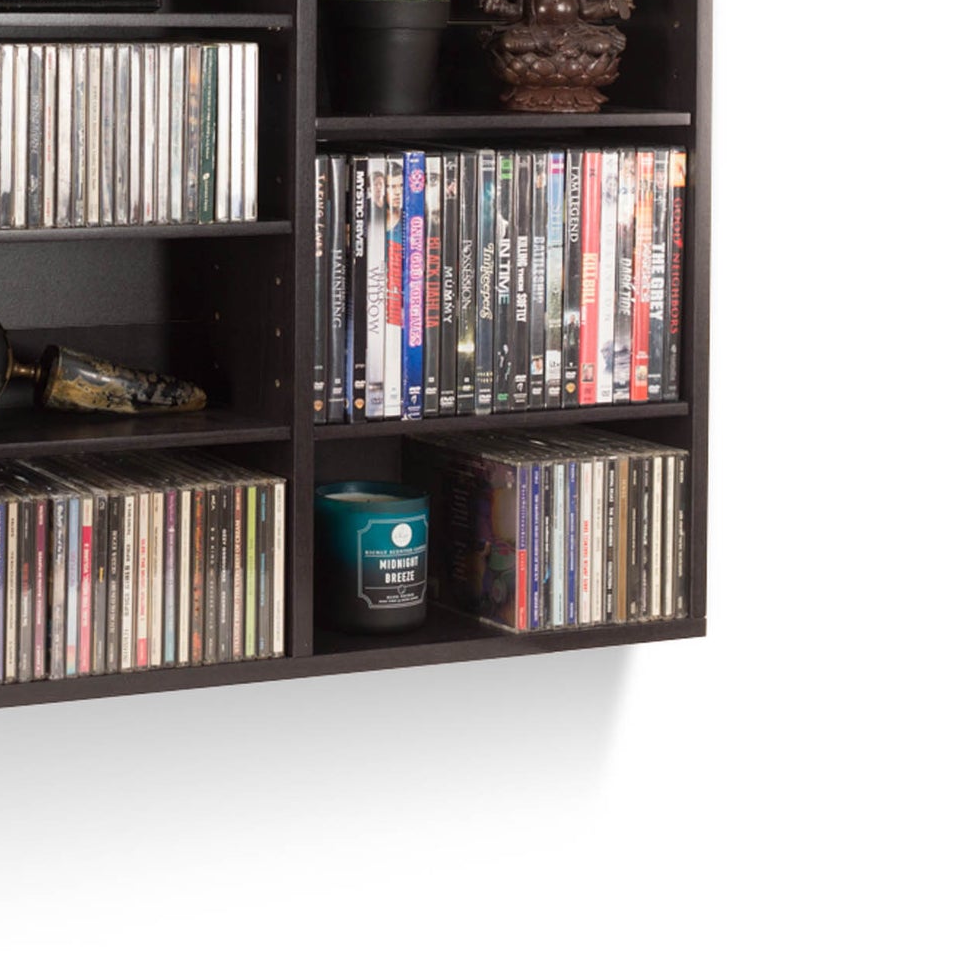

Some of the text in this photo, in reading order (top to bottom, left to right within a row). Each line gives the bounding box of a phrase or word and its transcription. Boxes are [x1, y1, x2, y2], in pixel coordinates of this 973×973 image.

[571, 173, 578, 192] AM
[355, 171, 363, 257] MYSTIC RIVER
[410, 217, 423, 251] ONLY
[570, 195, 578, 242] LEGEND
[410, 253, 423, 280] GOD
[462, 240, 472, 309] POSSESSION
[480, 244, 493, 319] Innkeepers
[497, 239, 509, 304] IN TIME
[517, 236, 527, 268] KILLING
[533, 237, 545, 303] BATTLESHIP
[582, 253, 597, 304] KILL BILL
[650, 243, 666, 320] THE GREY
[671, 197, 682, 334] GOOD NEIGHBORS
[332, 249, 341, 328] HAUNTING
[369, 267, 379, 334] WIDOW
[426, 237, 439, 328] BLACK DAHLIA
[443, 267, 453, 323] MUMMY
[516, 293, 527, 322] SOFTLY
[619, 257, 634, 316] DARK TIDE
[379, 556, 418, 570] MIDNIGHT
[385, 571, 415, 583] BREEZE
